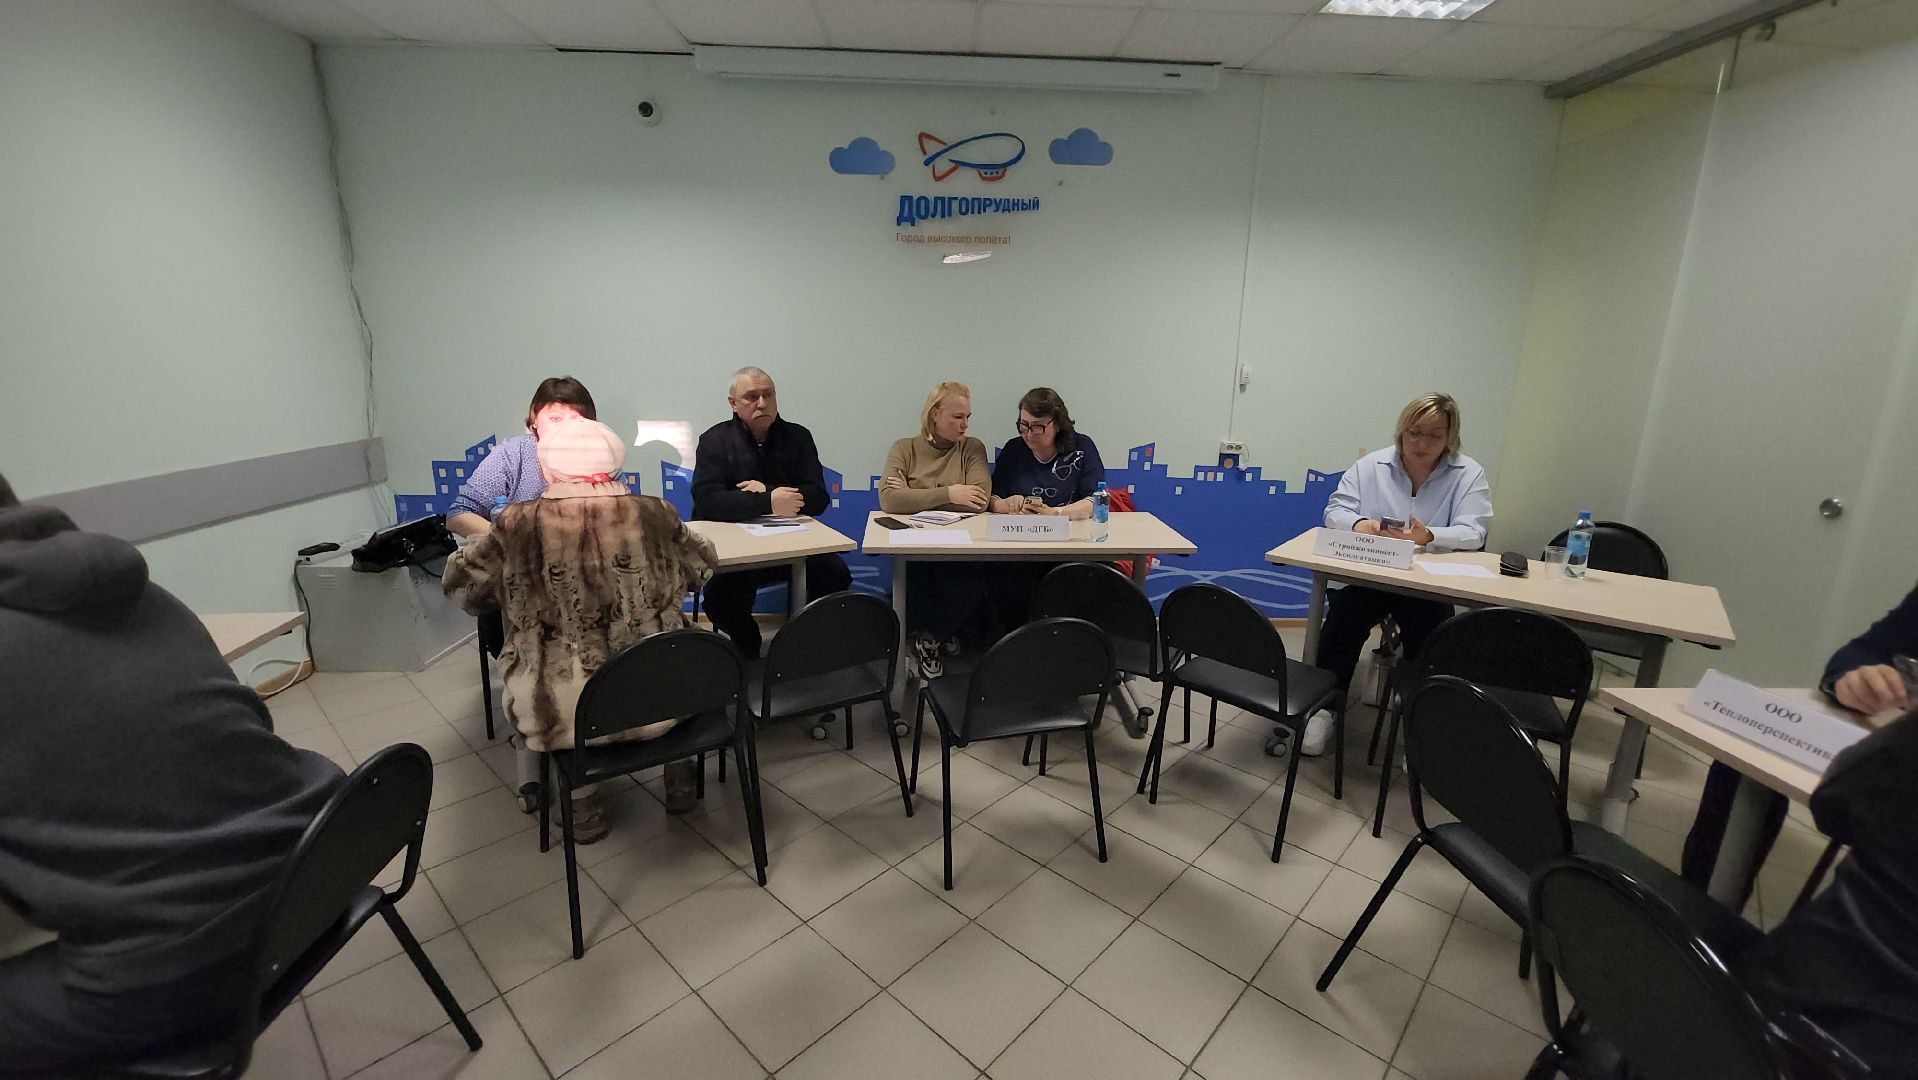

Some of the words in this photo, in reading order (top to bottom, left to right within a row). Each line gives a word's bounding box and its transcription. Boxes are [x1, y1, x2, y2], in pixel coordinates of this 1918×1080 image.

[896, 195, 1040, 227] ДОЛГОПРУДНЫЙ
[896, 232, 925, 245] Город
[927, 234, 972, 245] высокого
[1002, 525, 1023, 533] МУП
[1355, 536, 1375, 544] ООО
[1765, 702, 1803, 724] ООО
